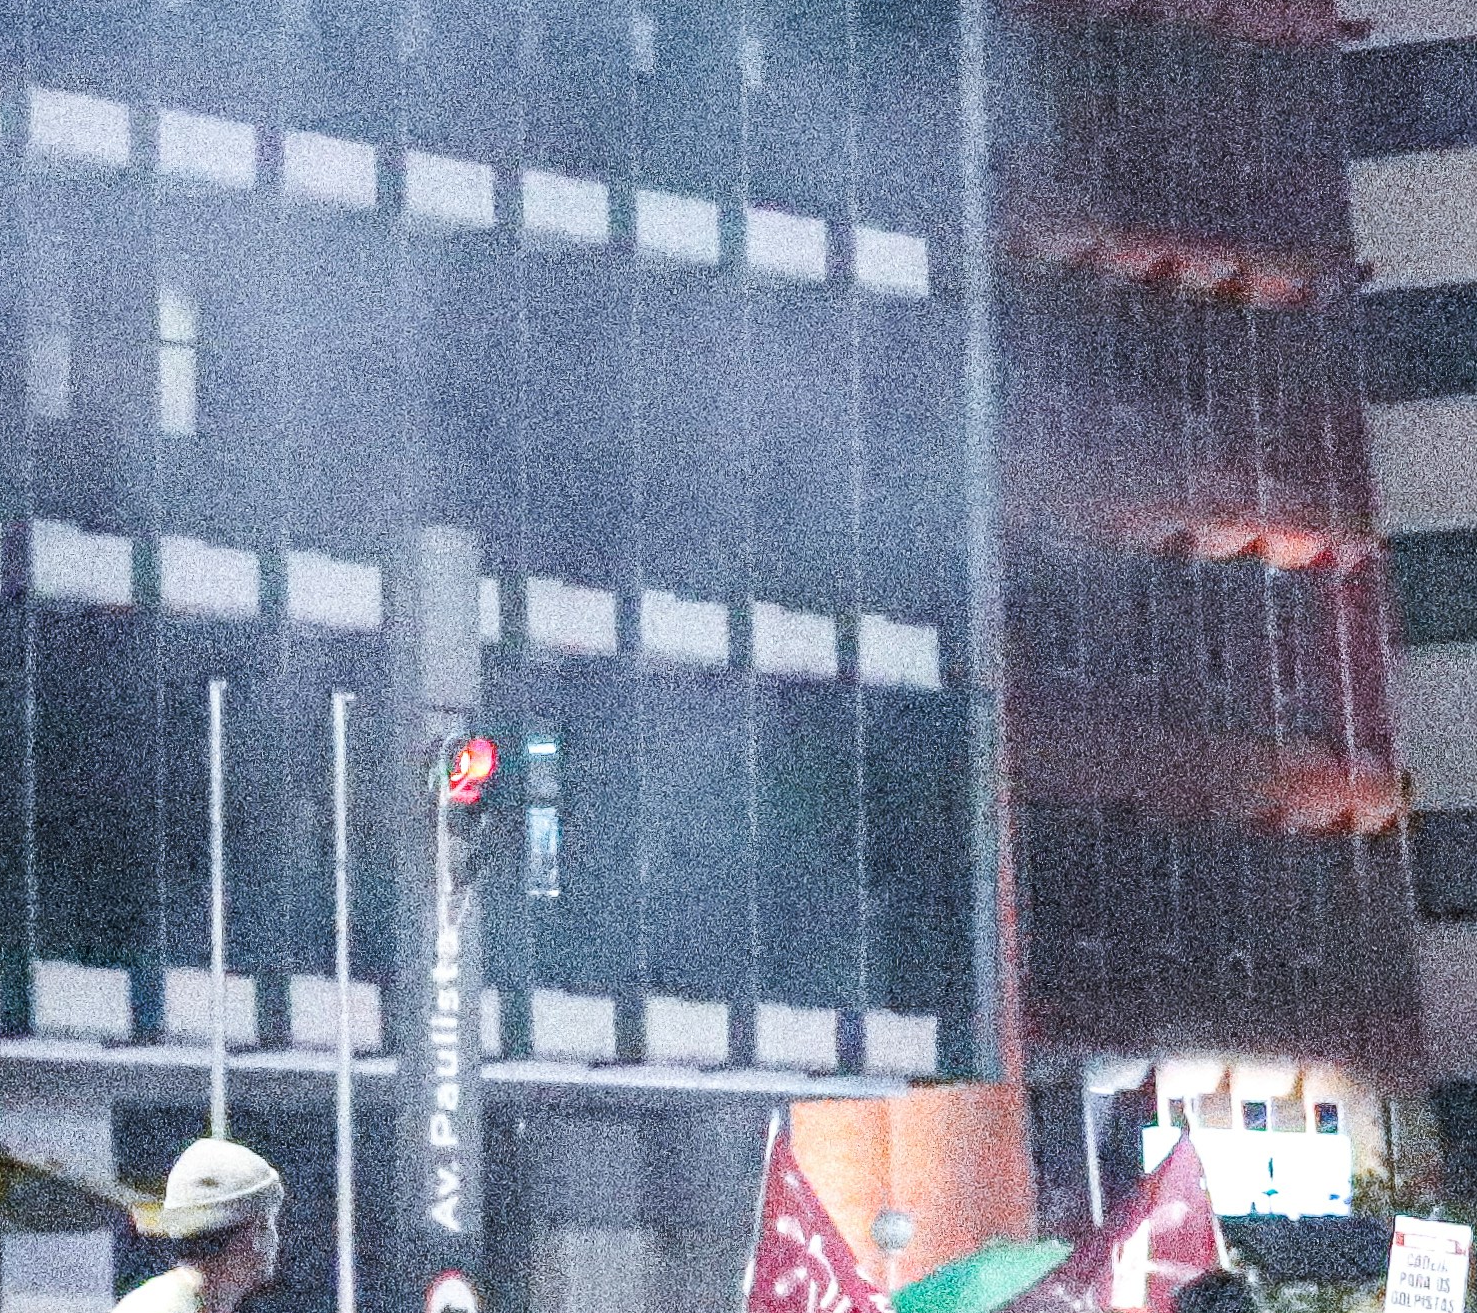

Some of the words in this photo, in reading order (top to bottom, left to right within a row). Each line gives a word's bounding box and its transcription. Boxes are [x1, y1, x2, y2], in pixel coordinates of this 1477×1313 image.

[431, 1161, 461, 1234] Av.
[1400, 1271, 1431, 1289] PARA
[1437, 1277, 1451, 1293] OS
